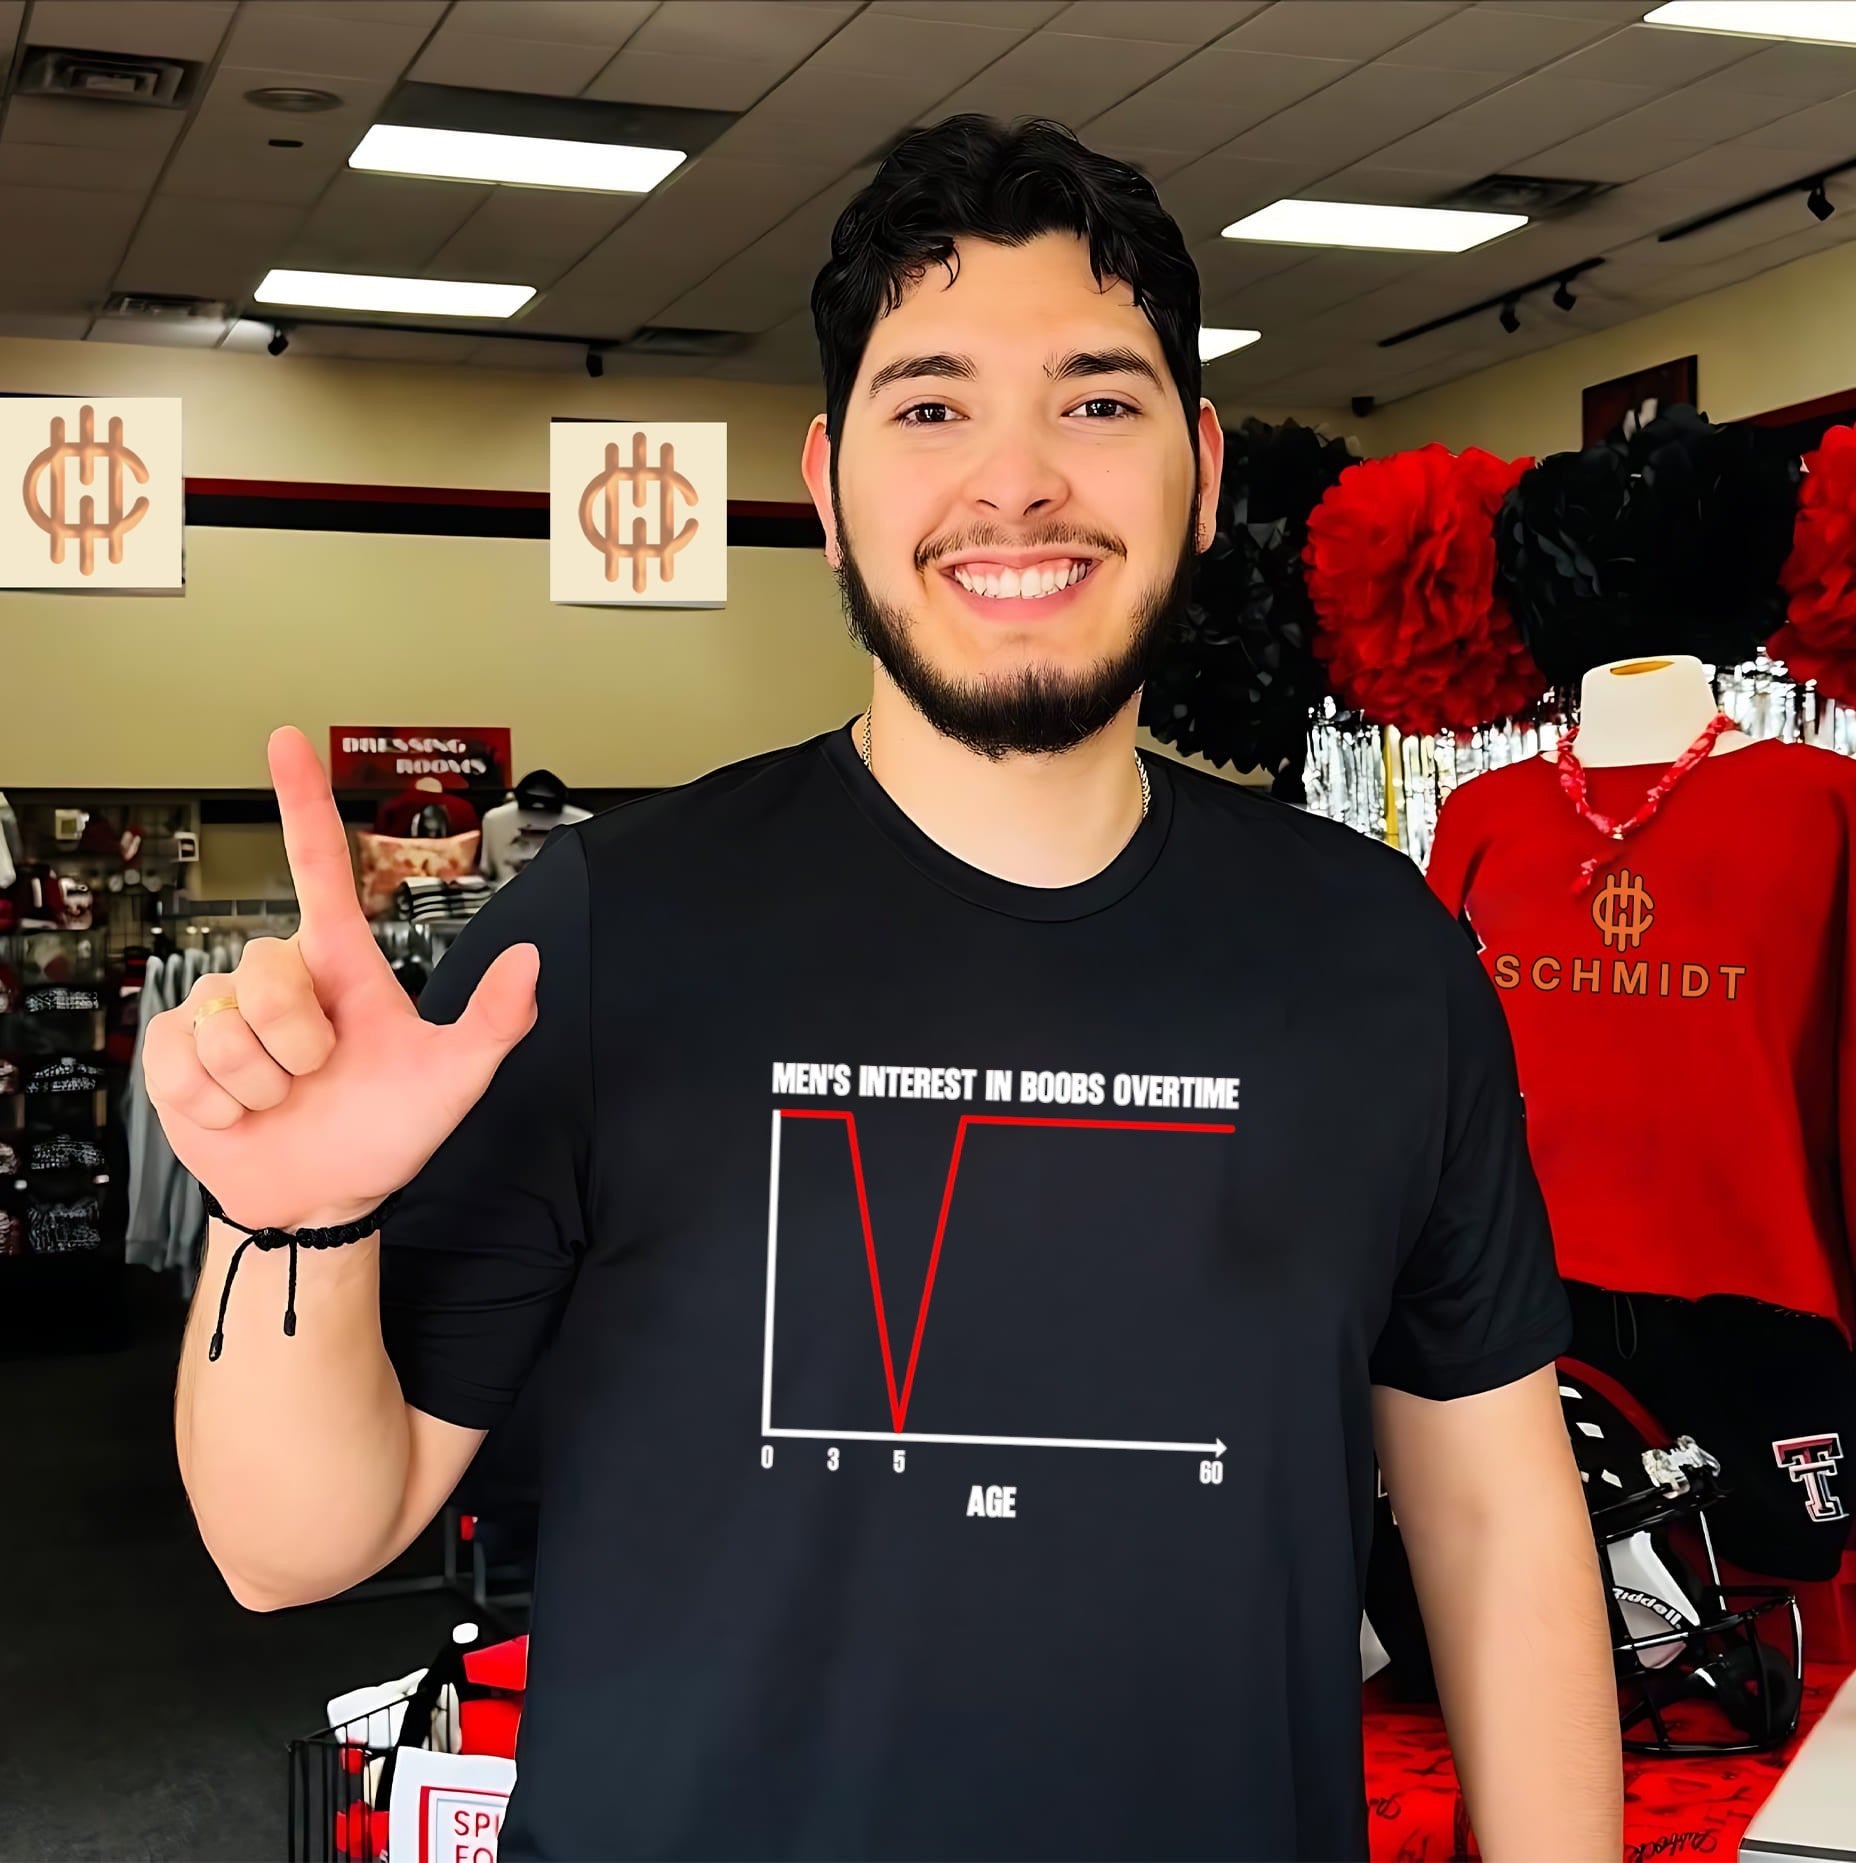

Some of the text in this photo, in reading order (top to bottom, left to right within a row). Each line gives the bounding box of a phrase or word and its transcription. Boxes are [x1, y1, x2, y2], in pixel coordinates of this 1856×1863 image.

[341, 736, 467, 754] DRESSING
[395, 757, 487, 775] ROOMS
[1494, 953, 1747, 1001] SCHMIDT
[771, 1061, 1241, 1110] MEN'S INTEREST IN BOOBS OVERTIME
[826, 1446, 840, 1472] 3
[892, 1449, 906, 1474] 5
[1199, 1459, 1224, 1485] 60
[965, 1484, 1018, 1519] AGE
